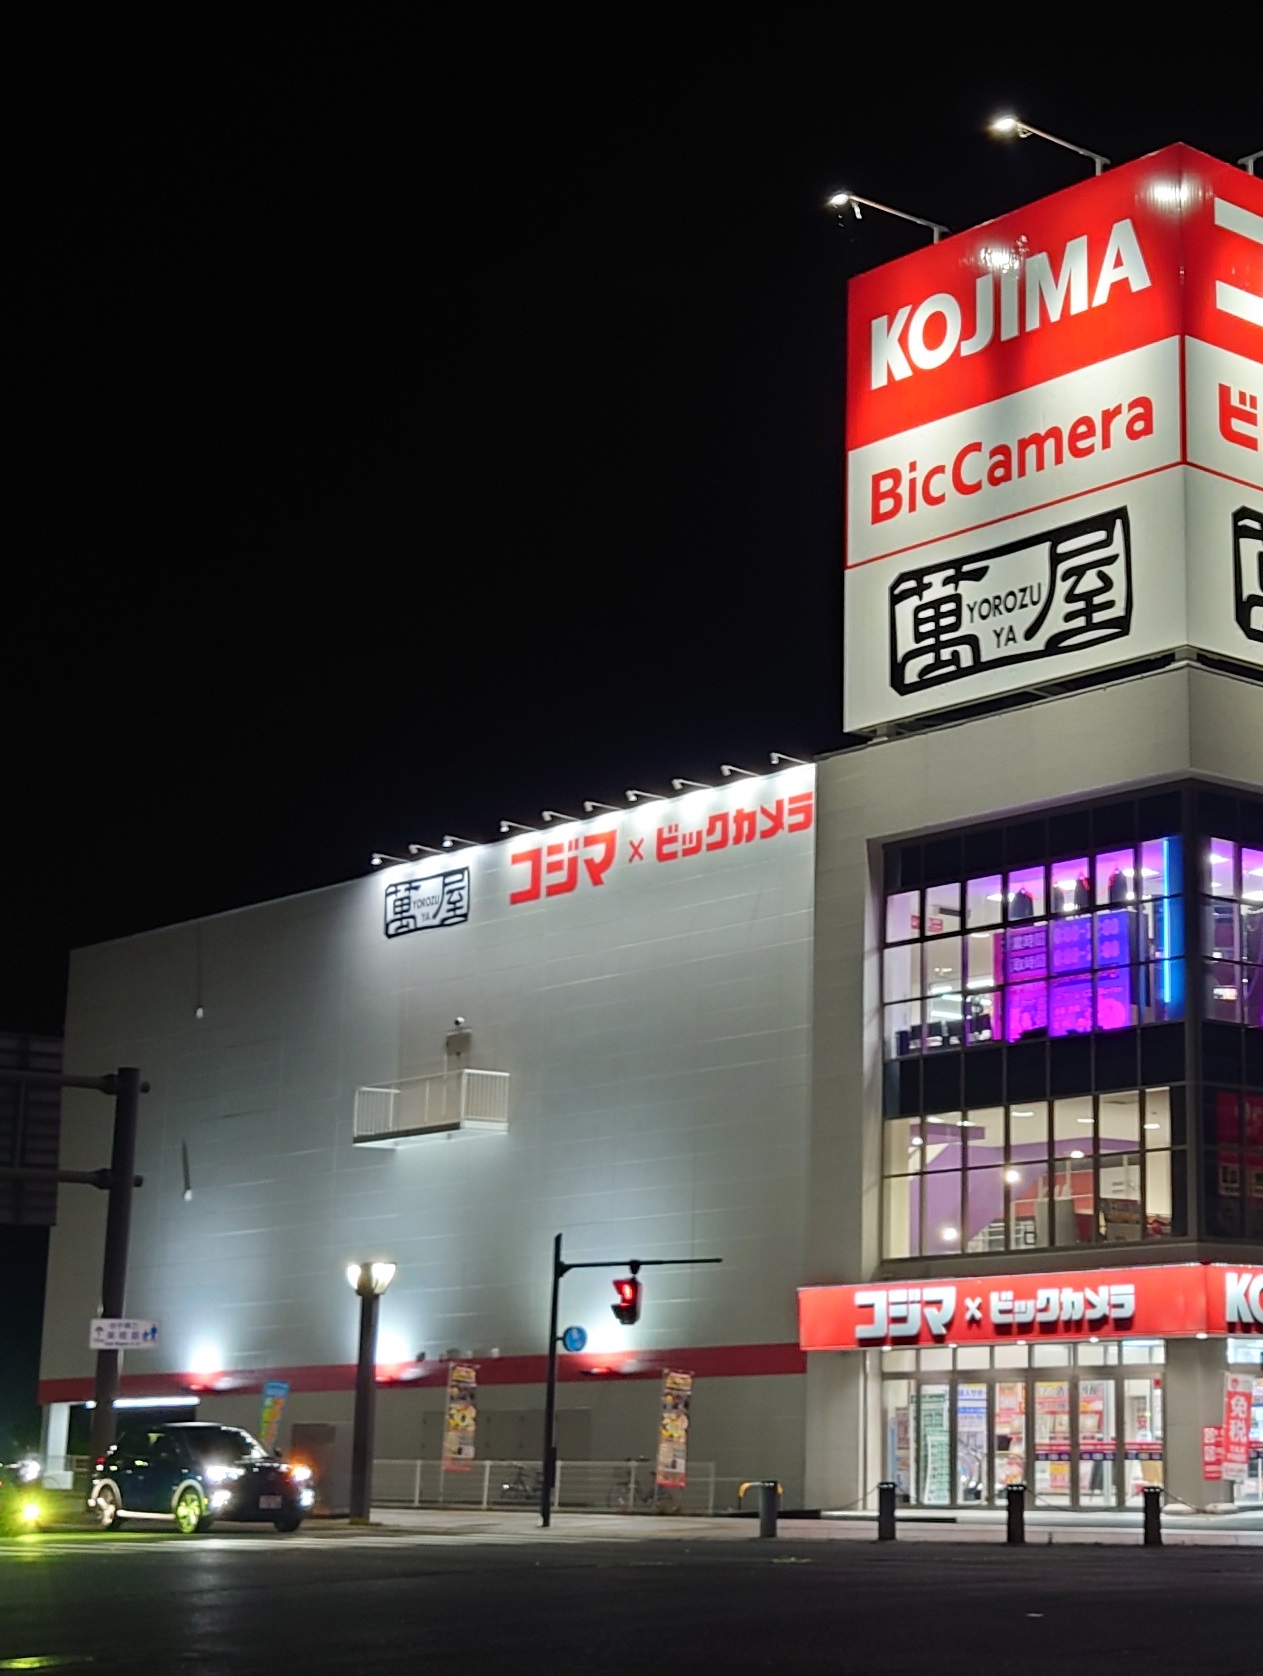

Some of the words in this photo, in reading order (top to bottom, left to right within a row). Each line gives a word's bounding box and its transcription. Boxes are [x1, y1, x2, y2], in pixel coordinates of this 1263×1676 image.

[869, 218, 1152, 390] KOJIMA
[869, 395, 1154, 525] BicCamera
[966, 581, 1042, 624] YOROZU
[992, 623, 1018, 650] YA
[854, 1286, 957, 1339] コジマ
[989, 1284, 1136, 1325] ビックカメラ
[1230, 1396, 1248, 1443] 免税
